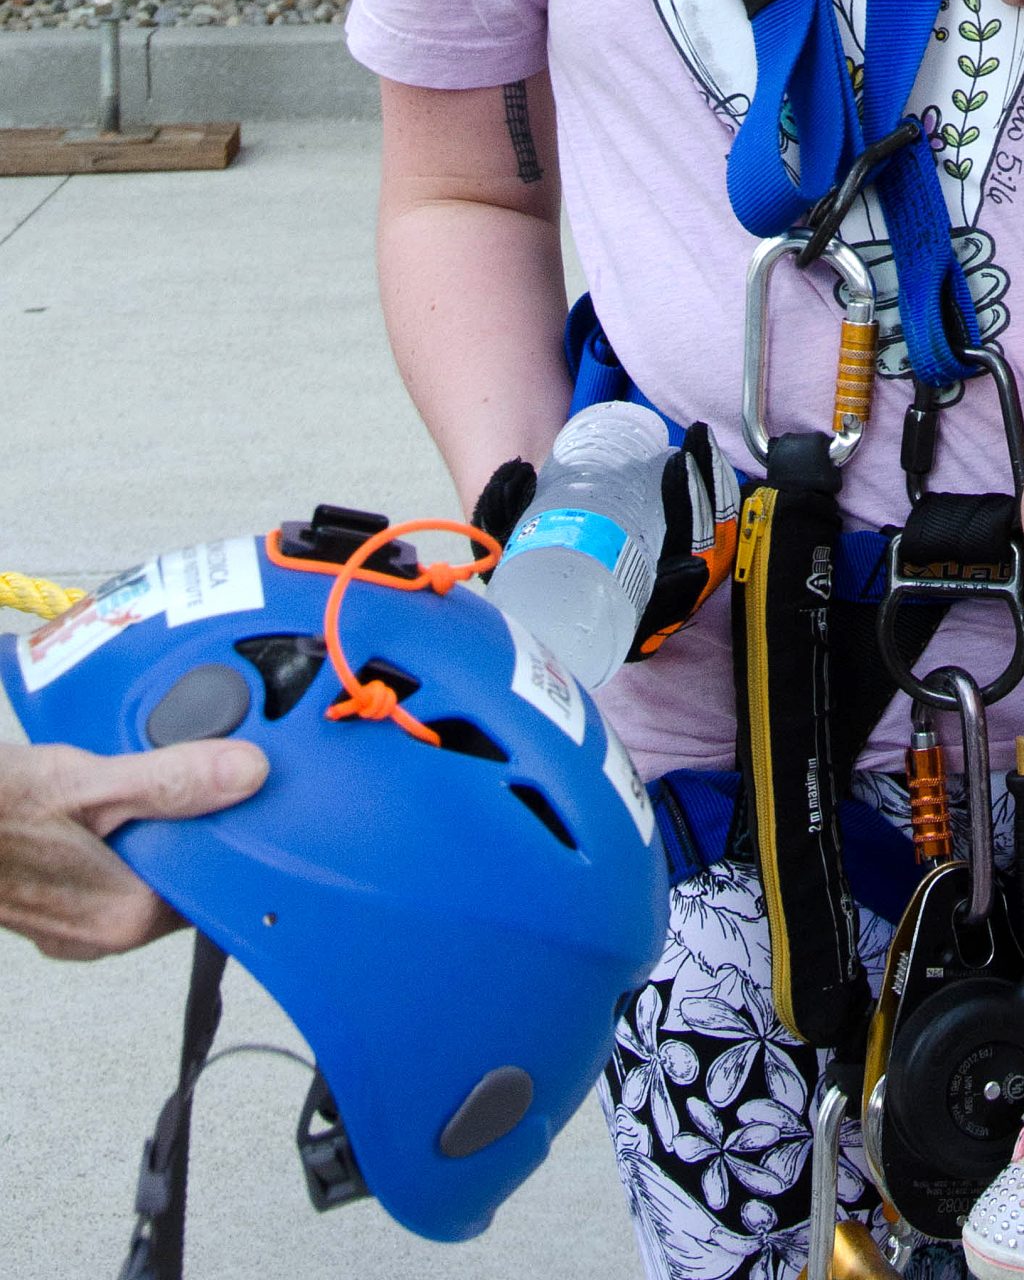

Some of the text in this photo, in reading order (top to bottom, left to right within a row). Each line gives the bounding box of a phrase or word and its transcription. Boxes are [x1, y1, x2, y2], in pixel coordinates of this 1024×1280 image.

[985, 151, 1023, 205] 5:16
[805, 758, 822, 833] 2 m maximm
